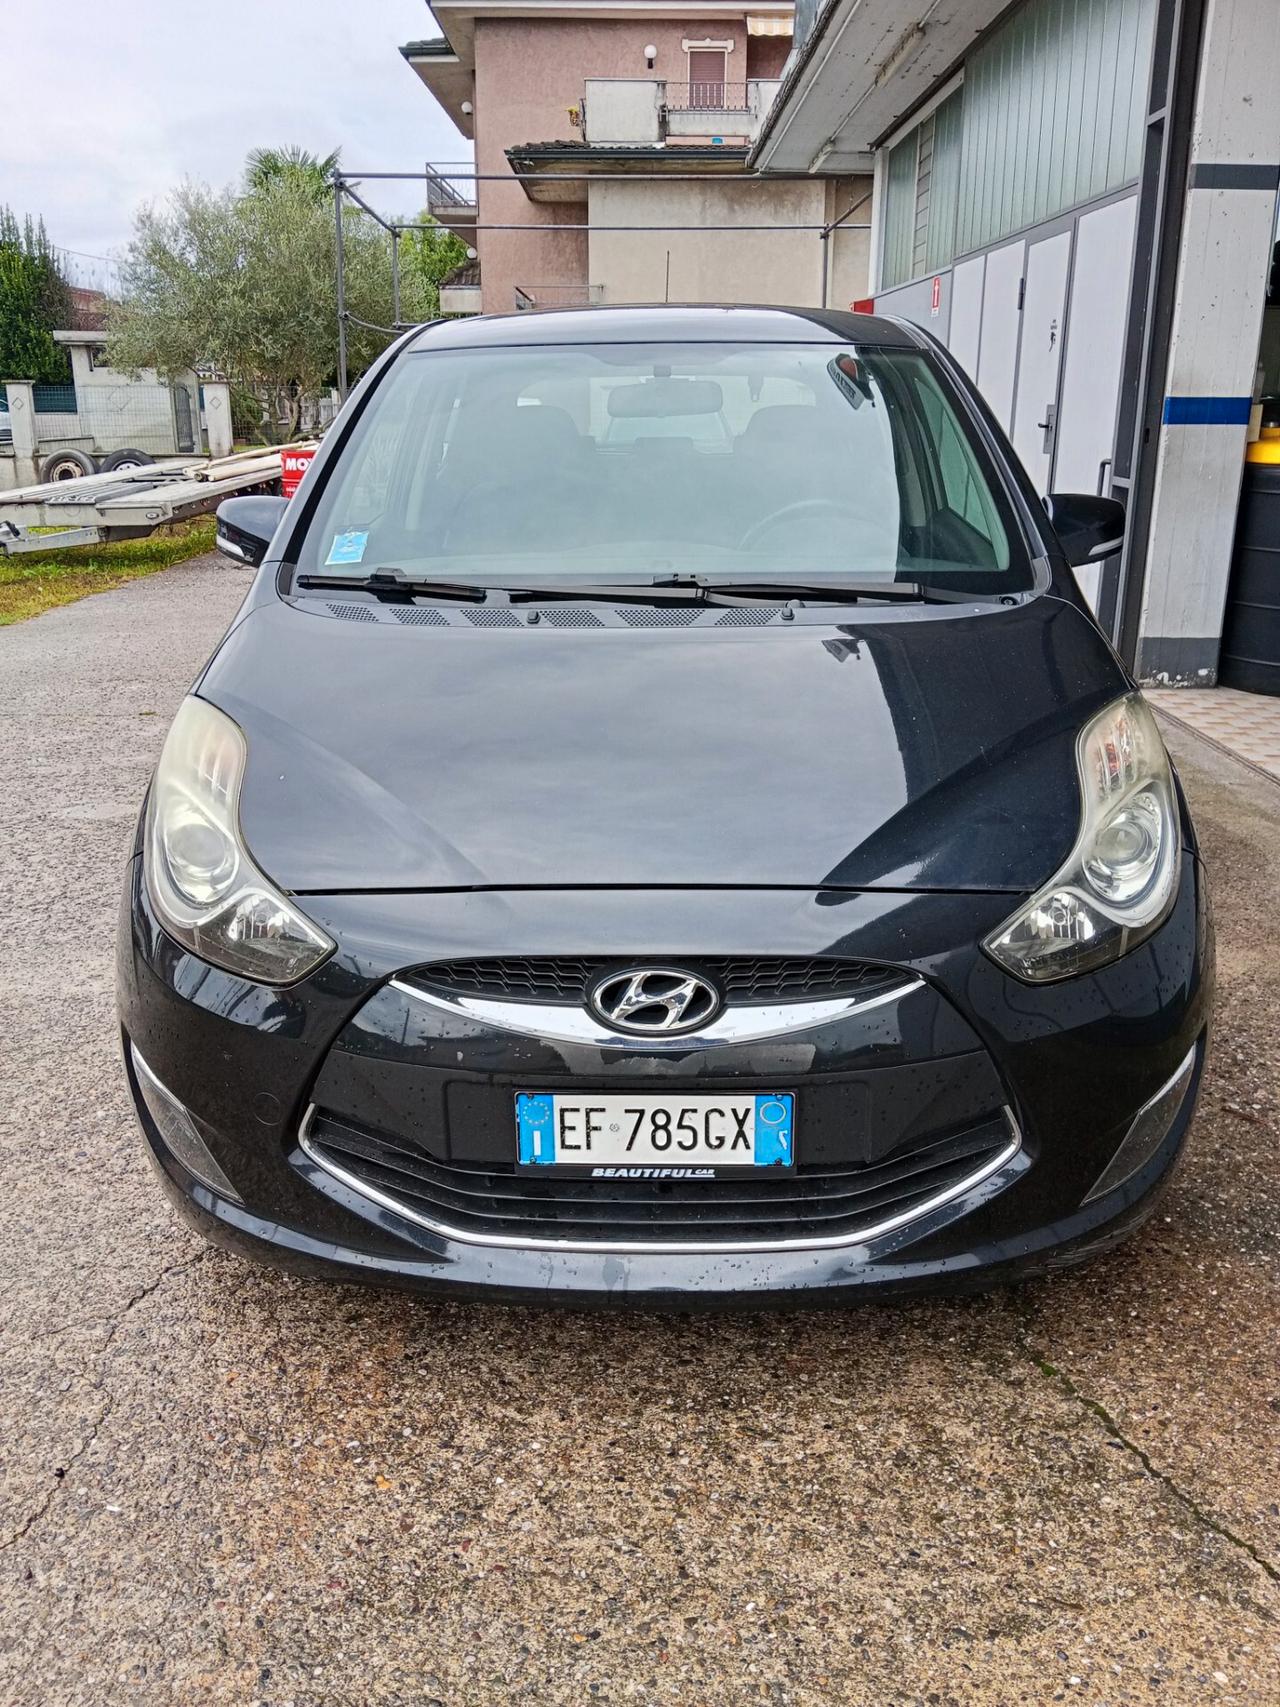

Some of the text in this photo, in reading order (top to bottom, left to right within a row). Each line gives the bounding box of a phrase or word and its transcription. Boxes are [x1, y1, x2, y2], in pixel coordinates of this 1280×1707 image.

[559, 1107, 606, 1150] EF
[624, 1107, 752, 1152] 785GX
[591, 1168, 695, 1178] BEAUTIFUL
